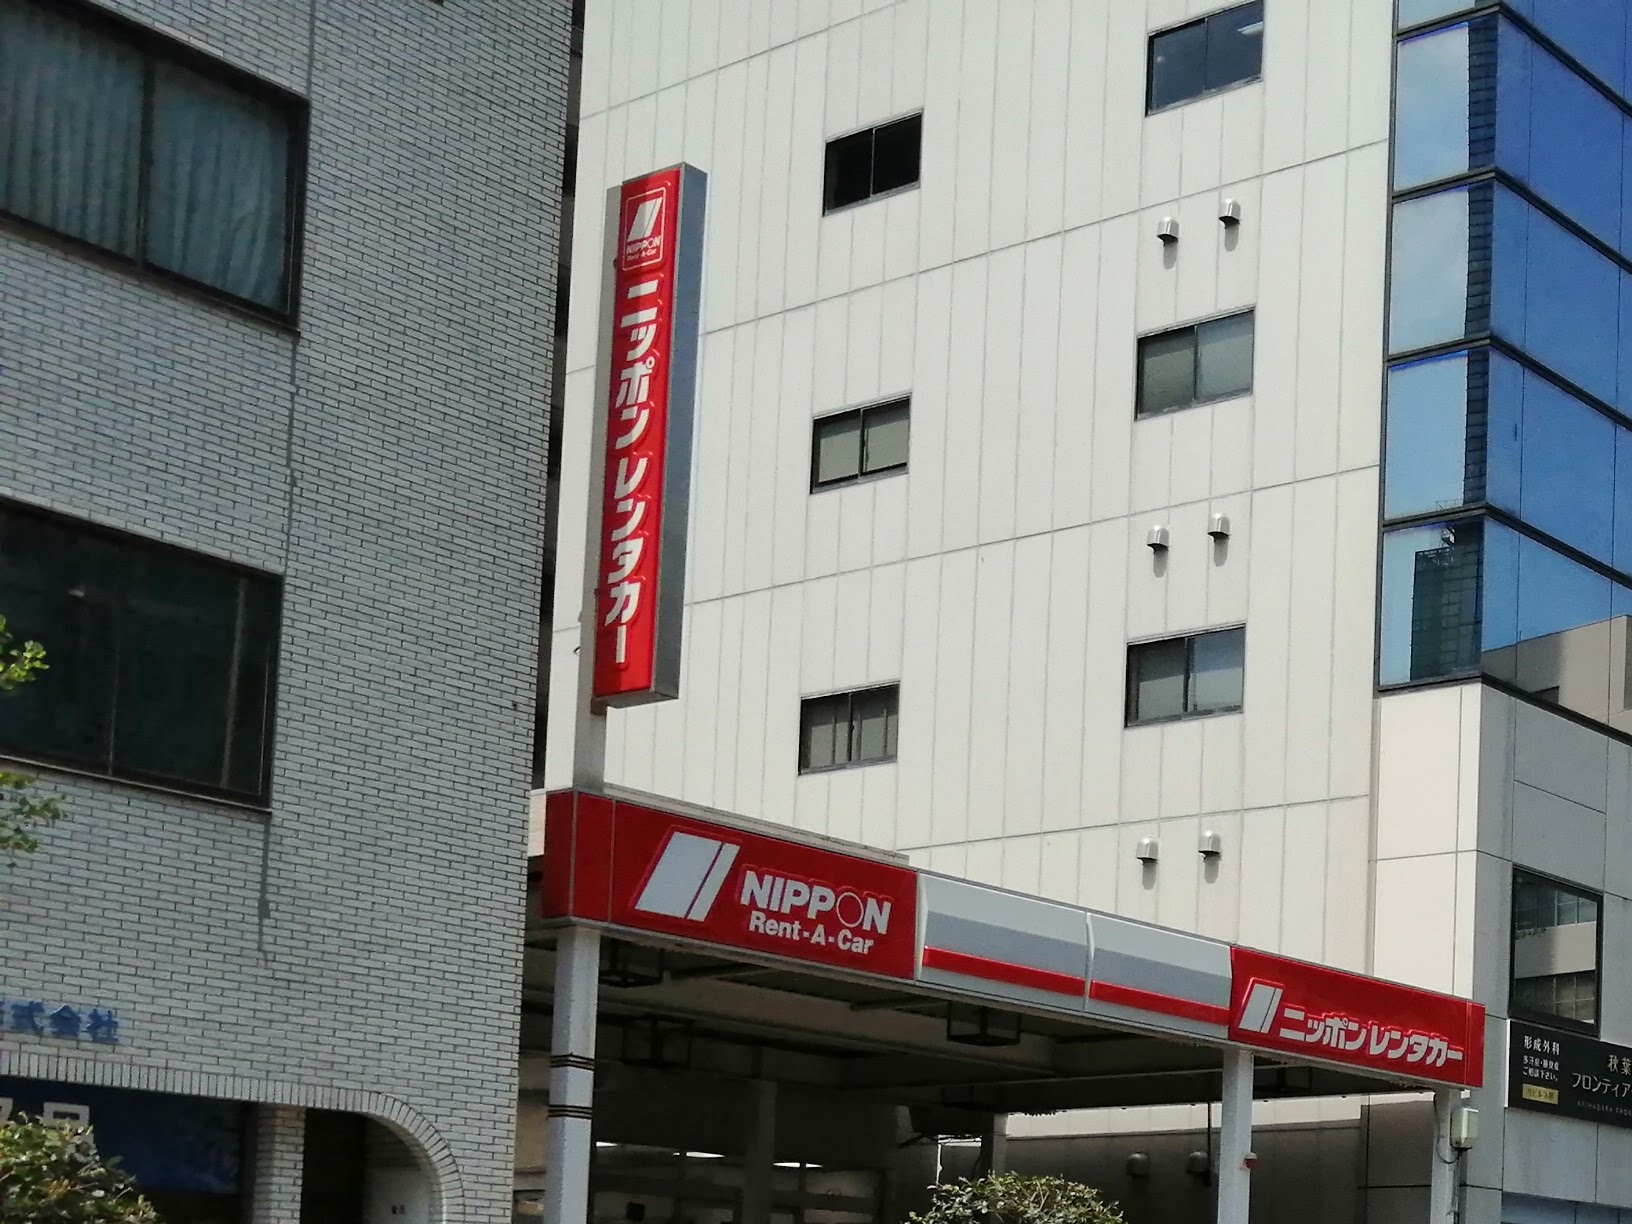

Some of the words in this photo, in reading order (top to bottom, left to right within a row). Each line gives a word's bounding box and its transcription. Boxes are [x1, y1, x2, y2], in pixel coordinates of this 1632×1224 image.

[604, 279, 659, 664] ニッポンレンタカー
[740, 870, 892, 935] NIPPON
[749, 911, 874, 955] Rent-A-Car
[0, 1000, 119, 1044] 式会社
[1279, 1006, 1464, 1068] ニッポンレンタカー
